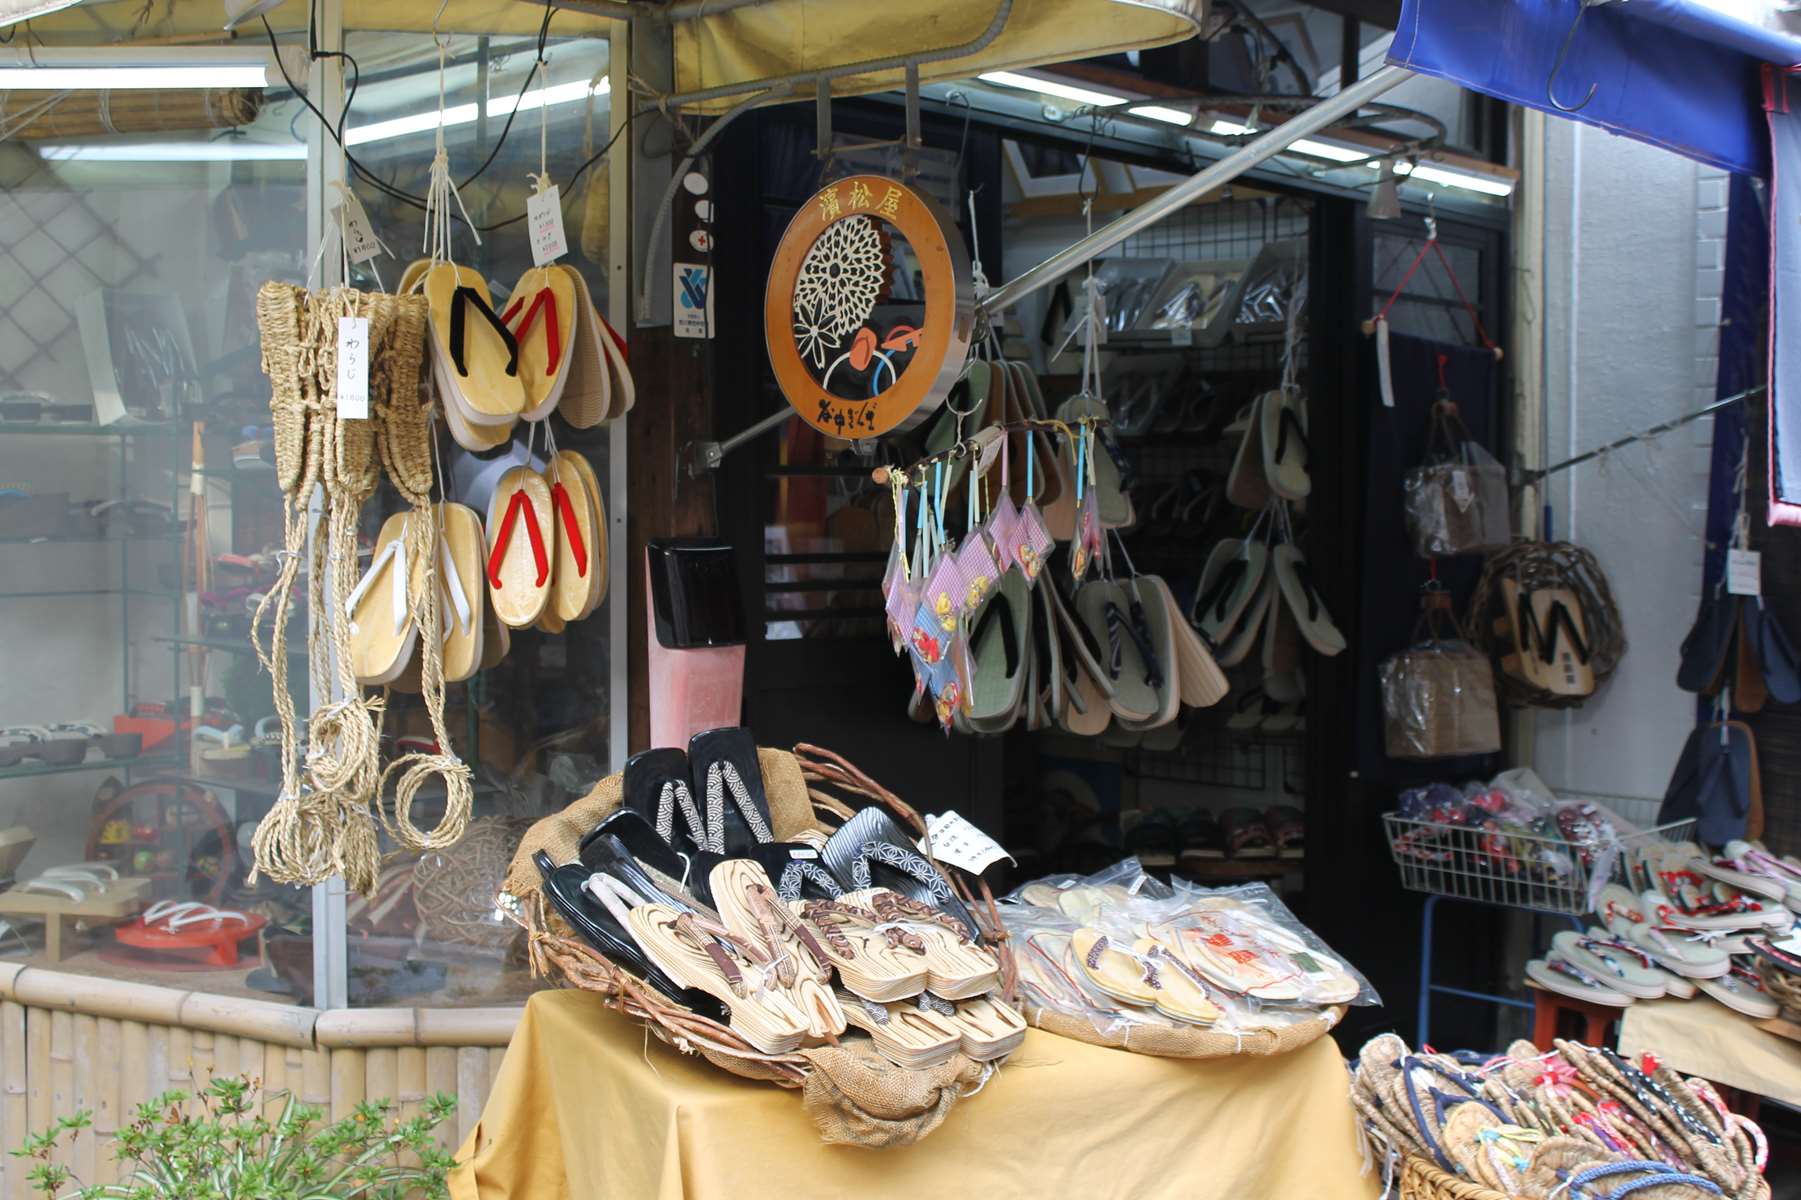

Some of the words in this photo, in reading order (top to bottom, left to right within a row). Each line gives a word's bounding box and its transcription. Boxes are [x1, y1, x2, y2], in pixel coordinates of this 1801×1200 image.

[819, 181, 902, 221] 濱松屋
[345, 337, 360, 380] わらじ
